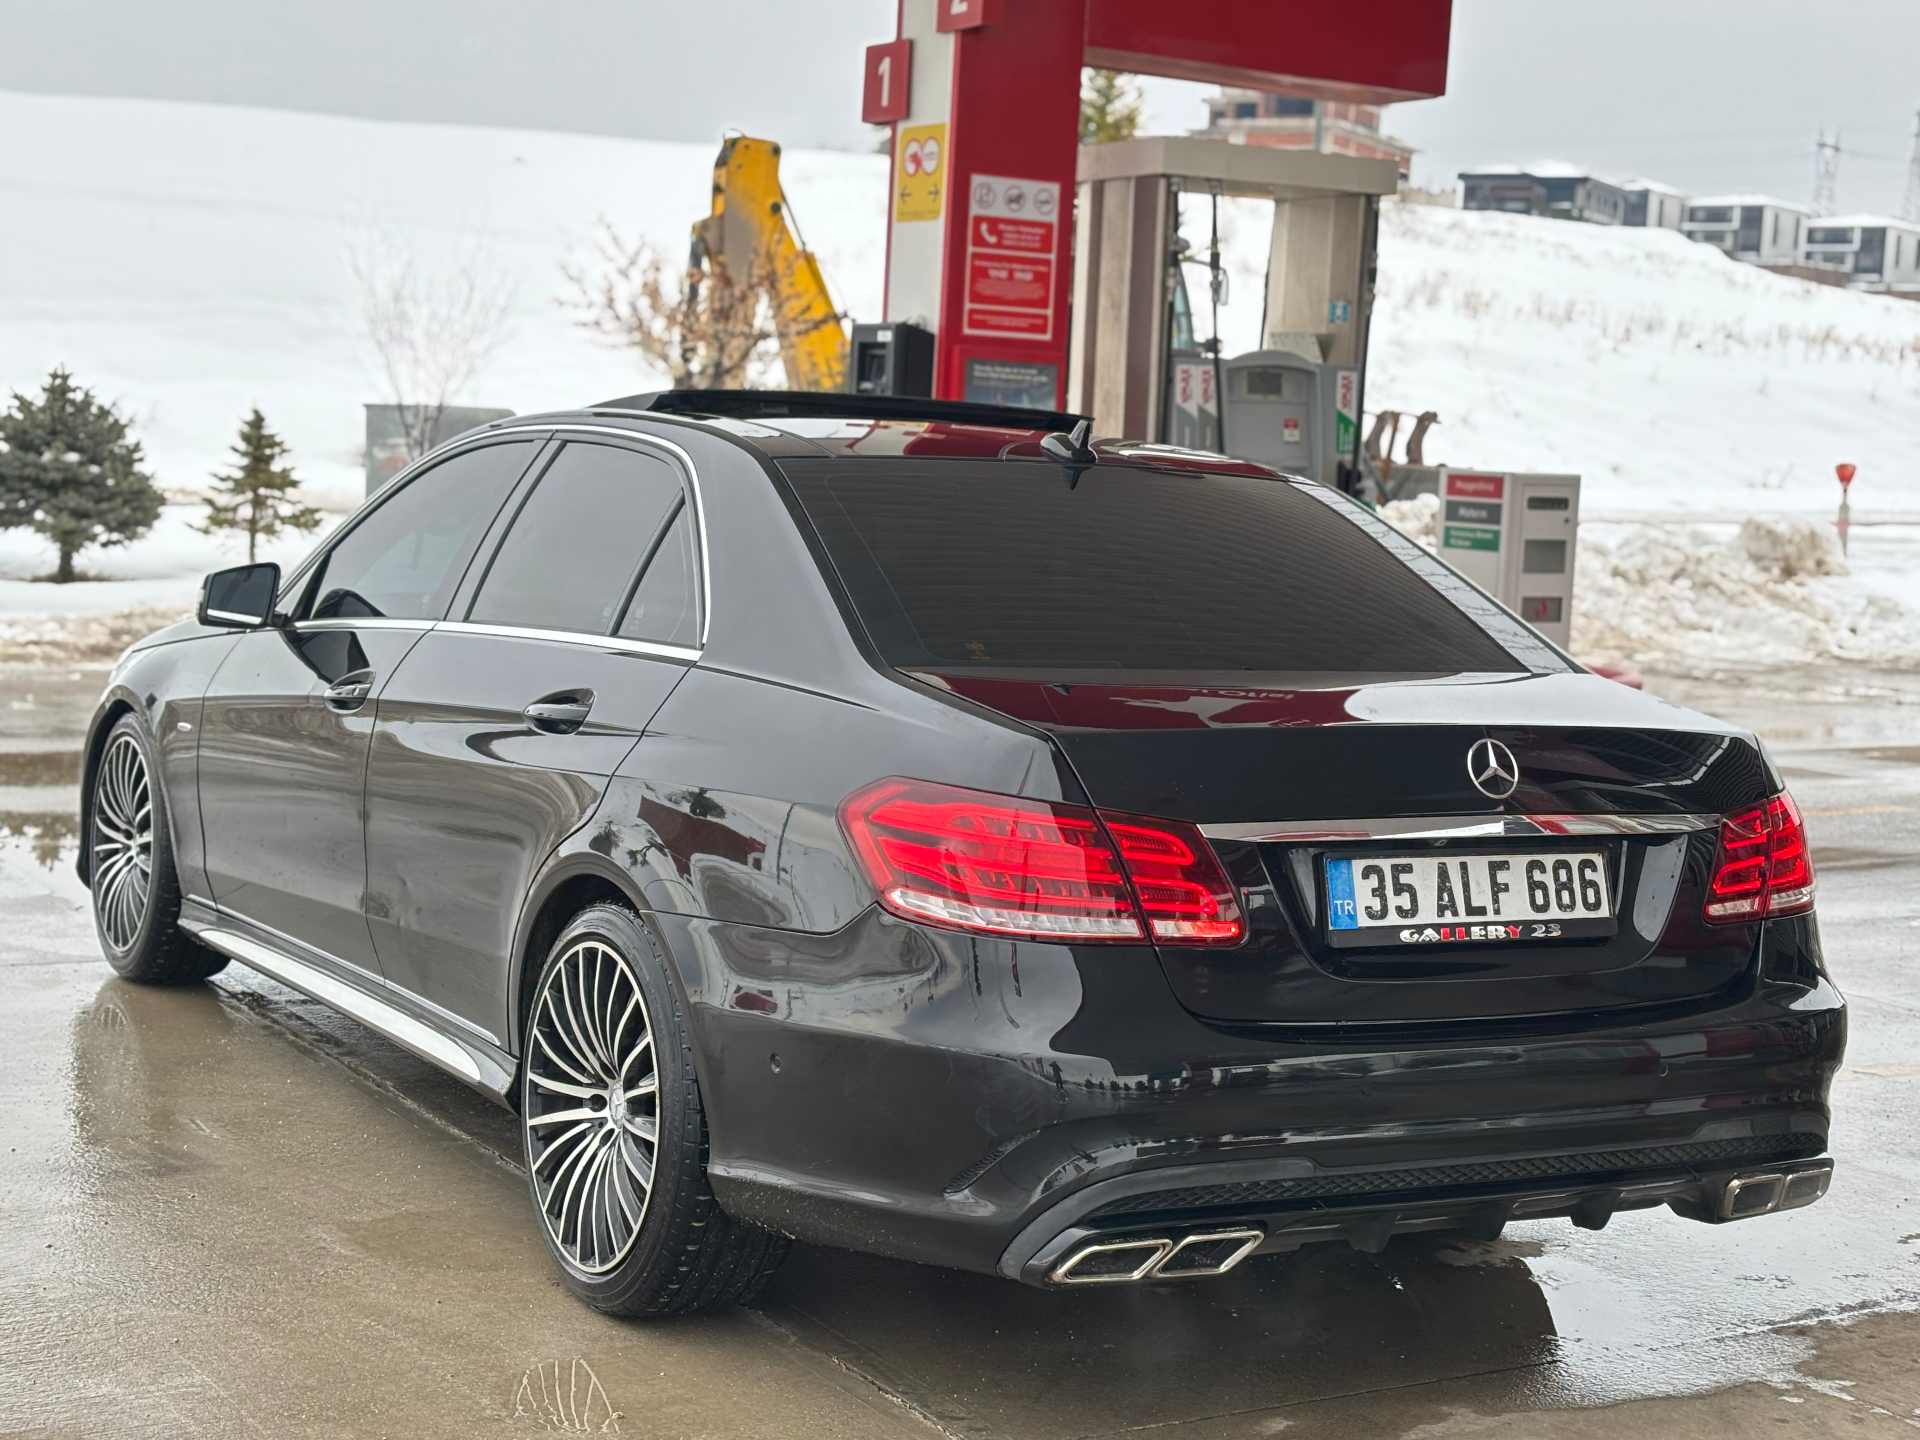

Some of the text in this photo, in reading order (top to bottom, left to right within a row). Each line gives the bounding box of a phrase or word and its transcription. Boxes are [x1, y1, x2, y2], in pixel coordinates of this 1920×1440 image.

[878, 56, 891, 107] 1
[1361, 858, 1602, 921] 35 ALF 686
[1334, 900, 1355, 916] TR
[1399, 923, 1562, 943] GALLERY 23
